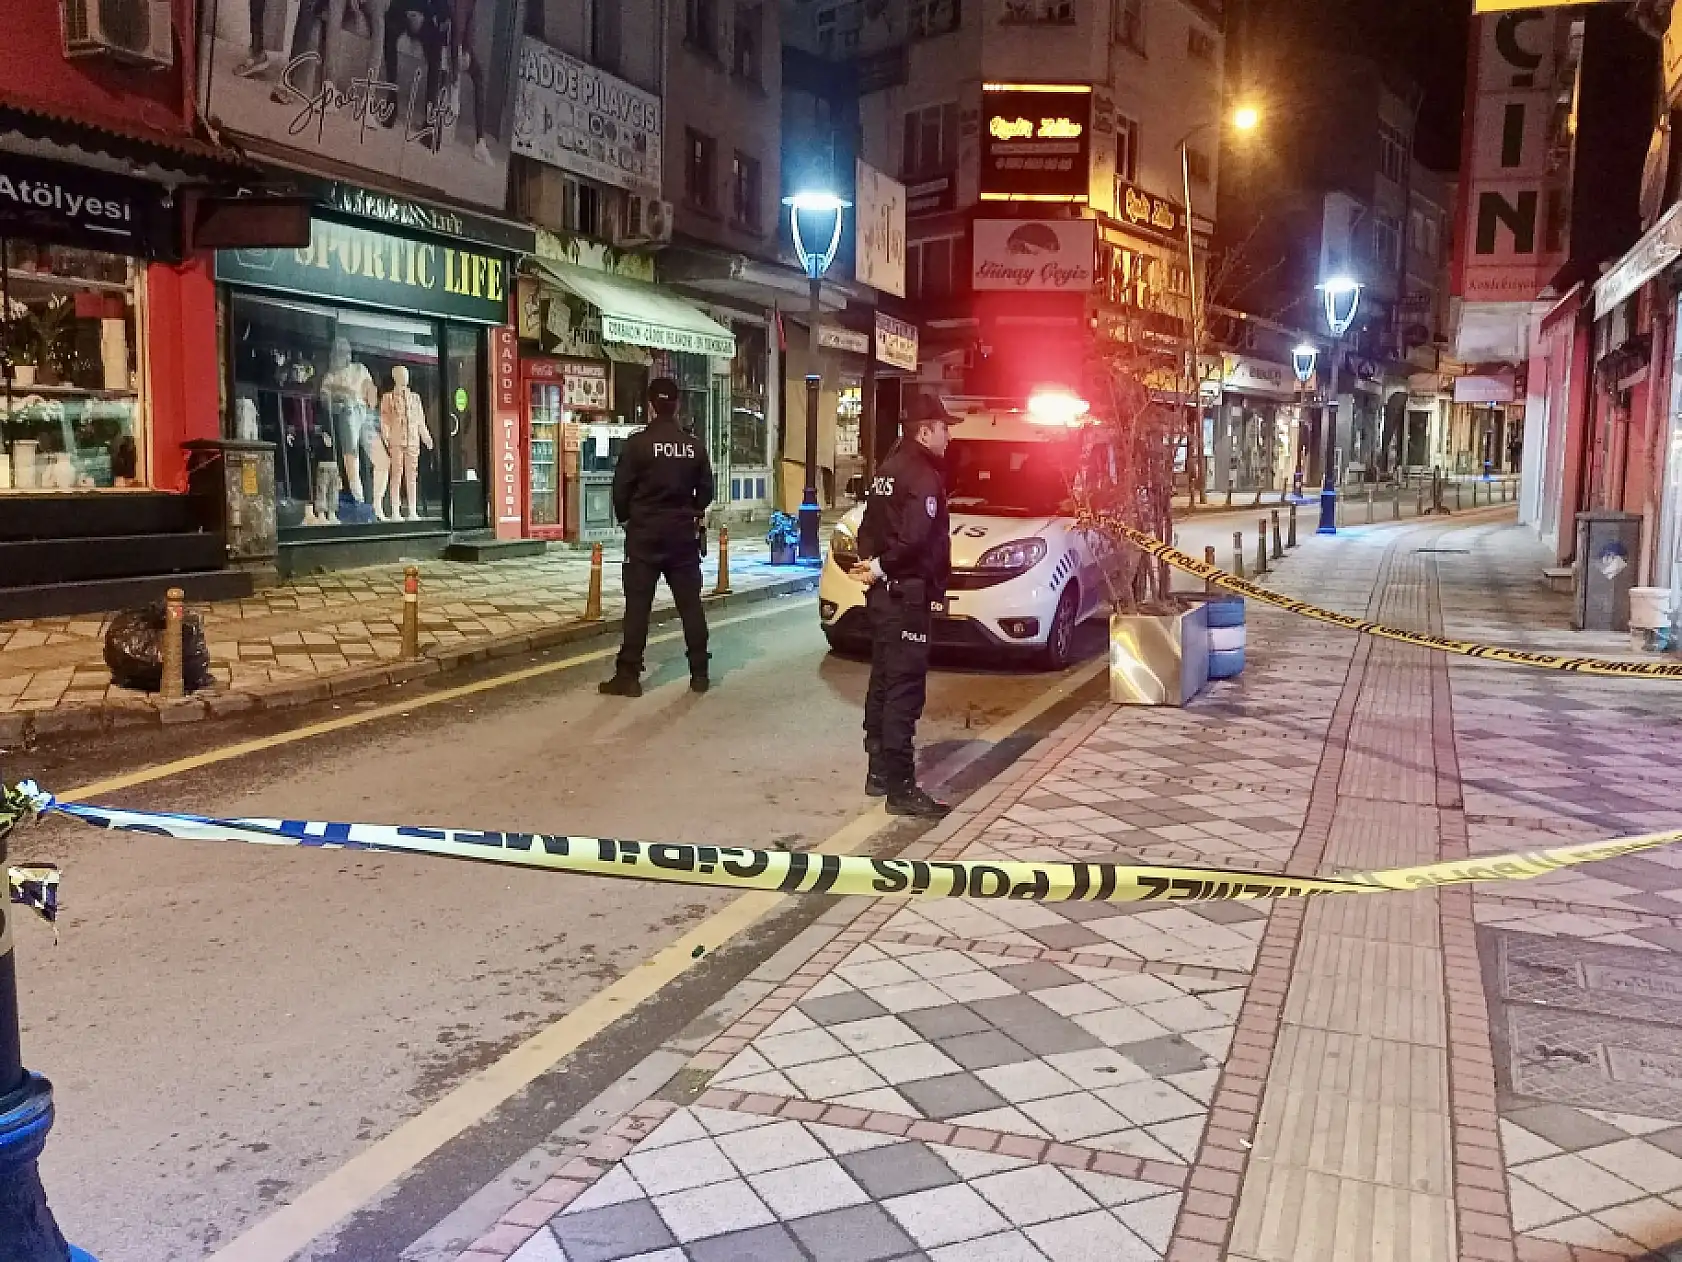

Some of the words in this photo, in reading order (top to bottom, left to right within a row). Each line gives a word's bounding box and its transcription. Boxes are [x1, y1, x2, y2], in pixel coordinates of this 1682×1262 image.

[519, 49, 579, 100] ADDE
[444, 248, 503, 301] LIFE
[502, 333, 513, 405] CADDE
